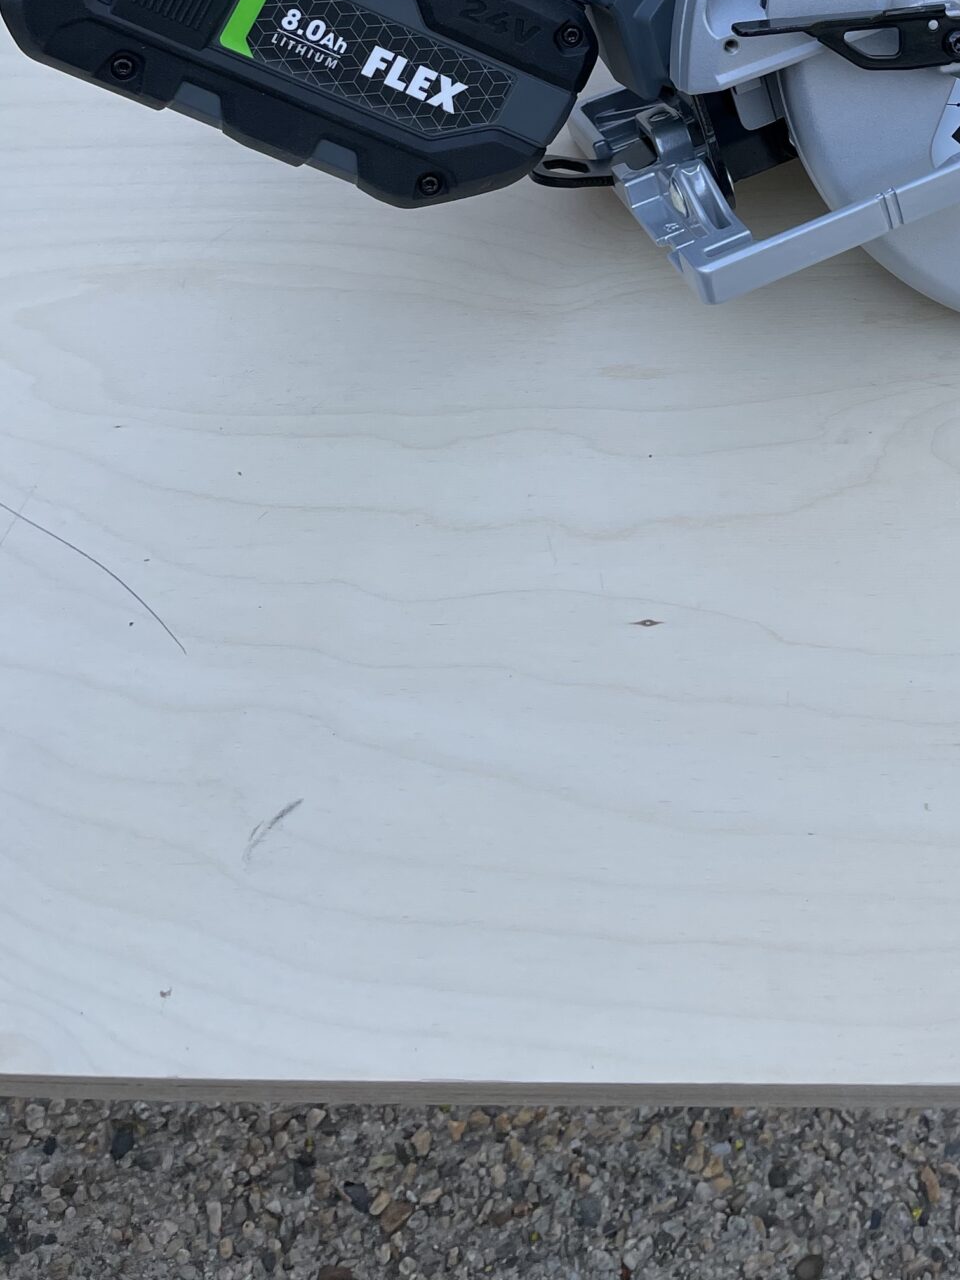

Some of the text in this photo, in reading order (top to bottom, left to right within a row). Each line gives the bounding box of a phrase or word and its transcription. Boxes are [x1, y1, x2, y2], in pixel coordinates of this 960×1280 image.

[270, 33, 339, 70] LITHIUM
[280, 8, 348, 55] 8.0Ah
[360, 45, 469, 114] FLEX
